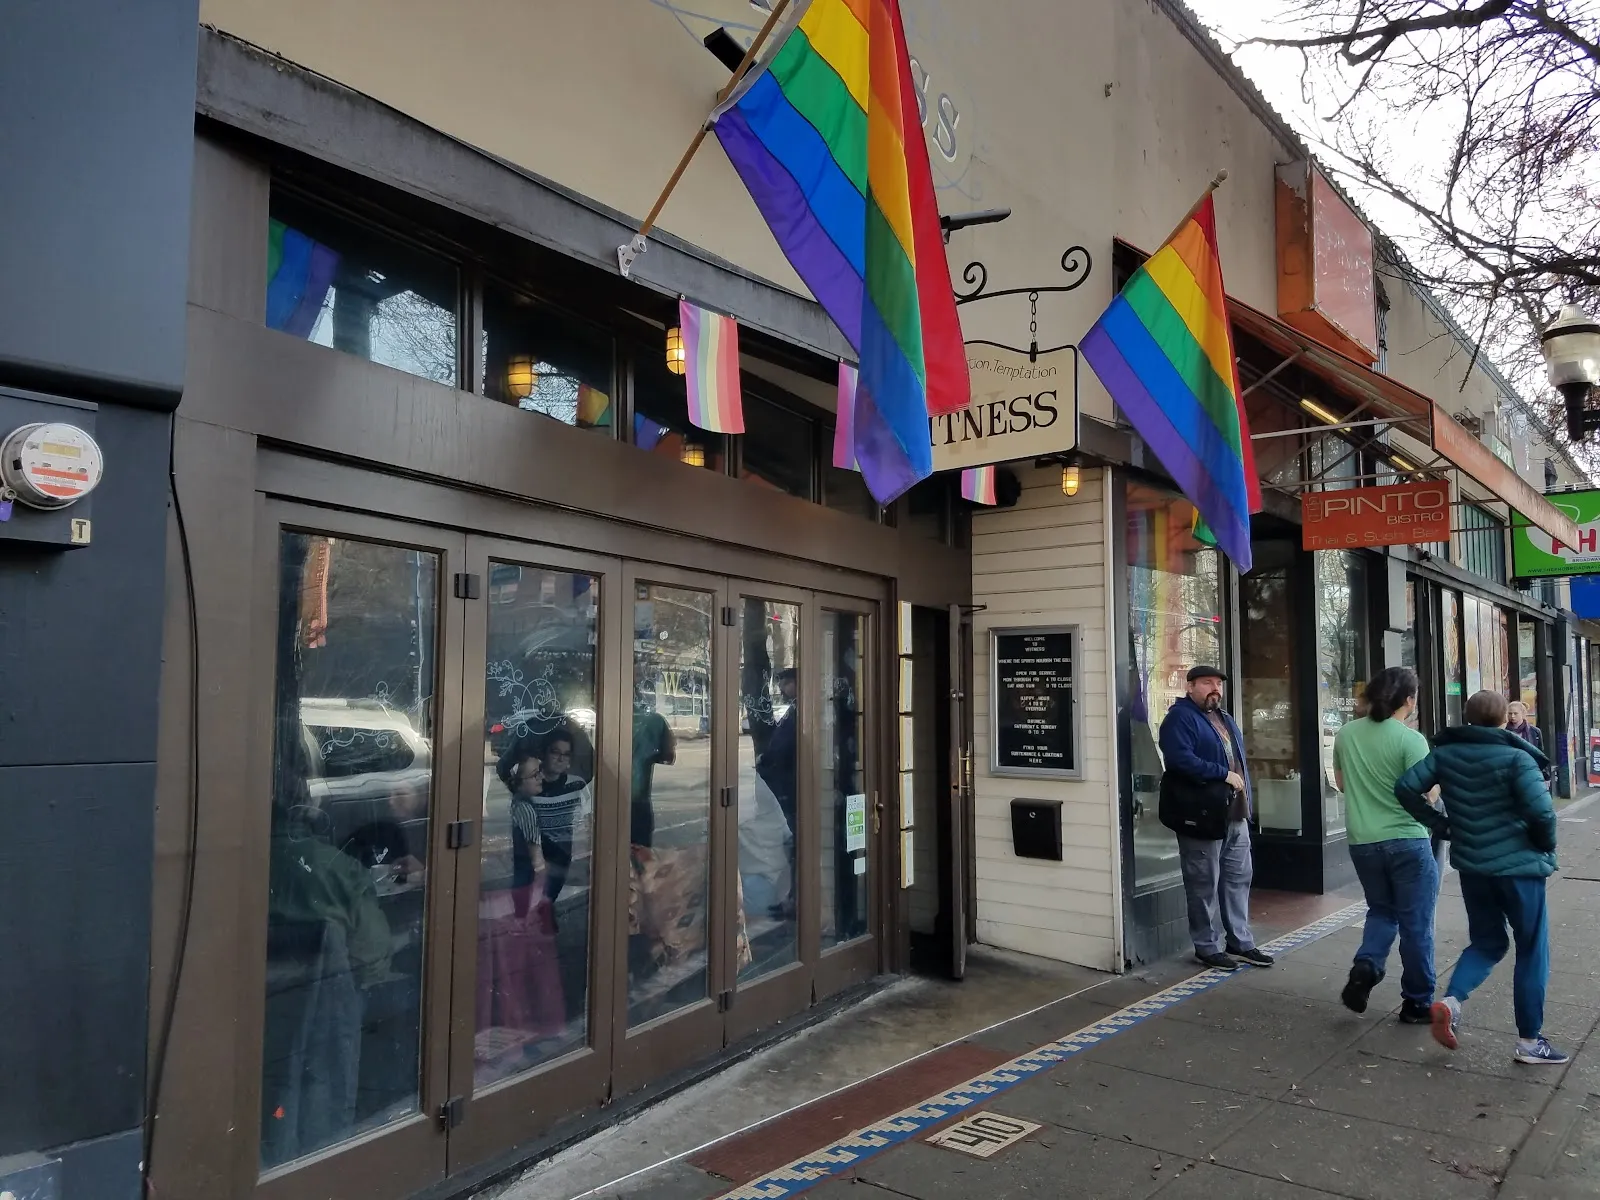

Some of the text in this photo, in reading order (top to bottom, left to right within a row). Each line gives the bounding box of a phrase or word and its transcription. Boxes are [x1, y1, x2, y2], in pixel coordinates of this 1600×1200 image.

[1324, 490, 1444, 518] PINTO
[1386, 512, 1444, 525] BISTRO
[75, 520, 87, 539] T
[1345, 533, 1358, 544] &
[1412, 527, 1440, 539] Bar
